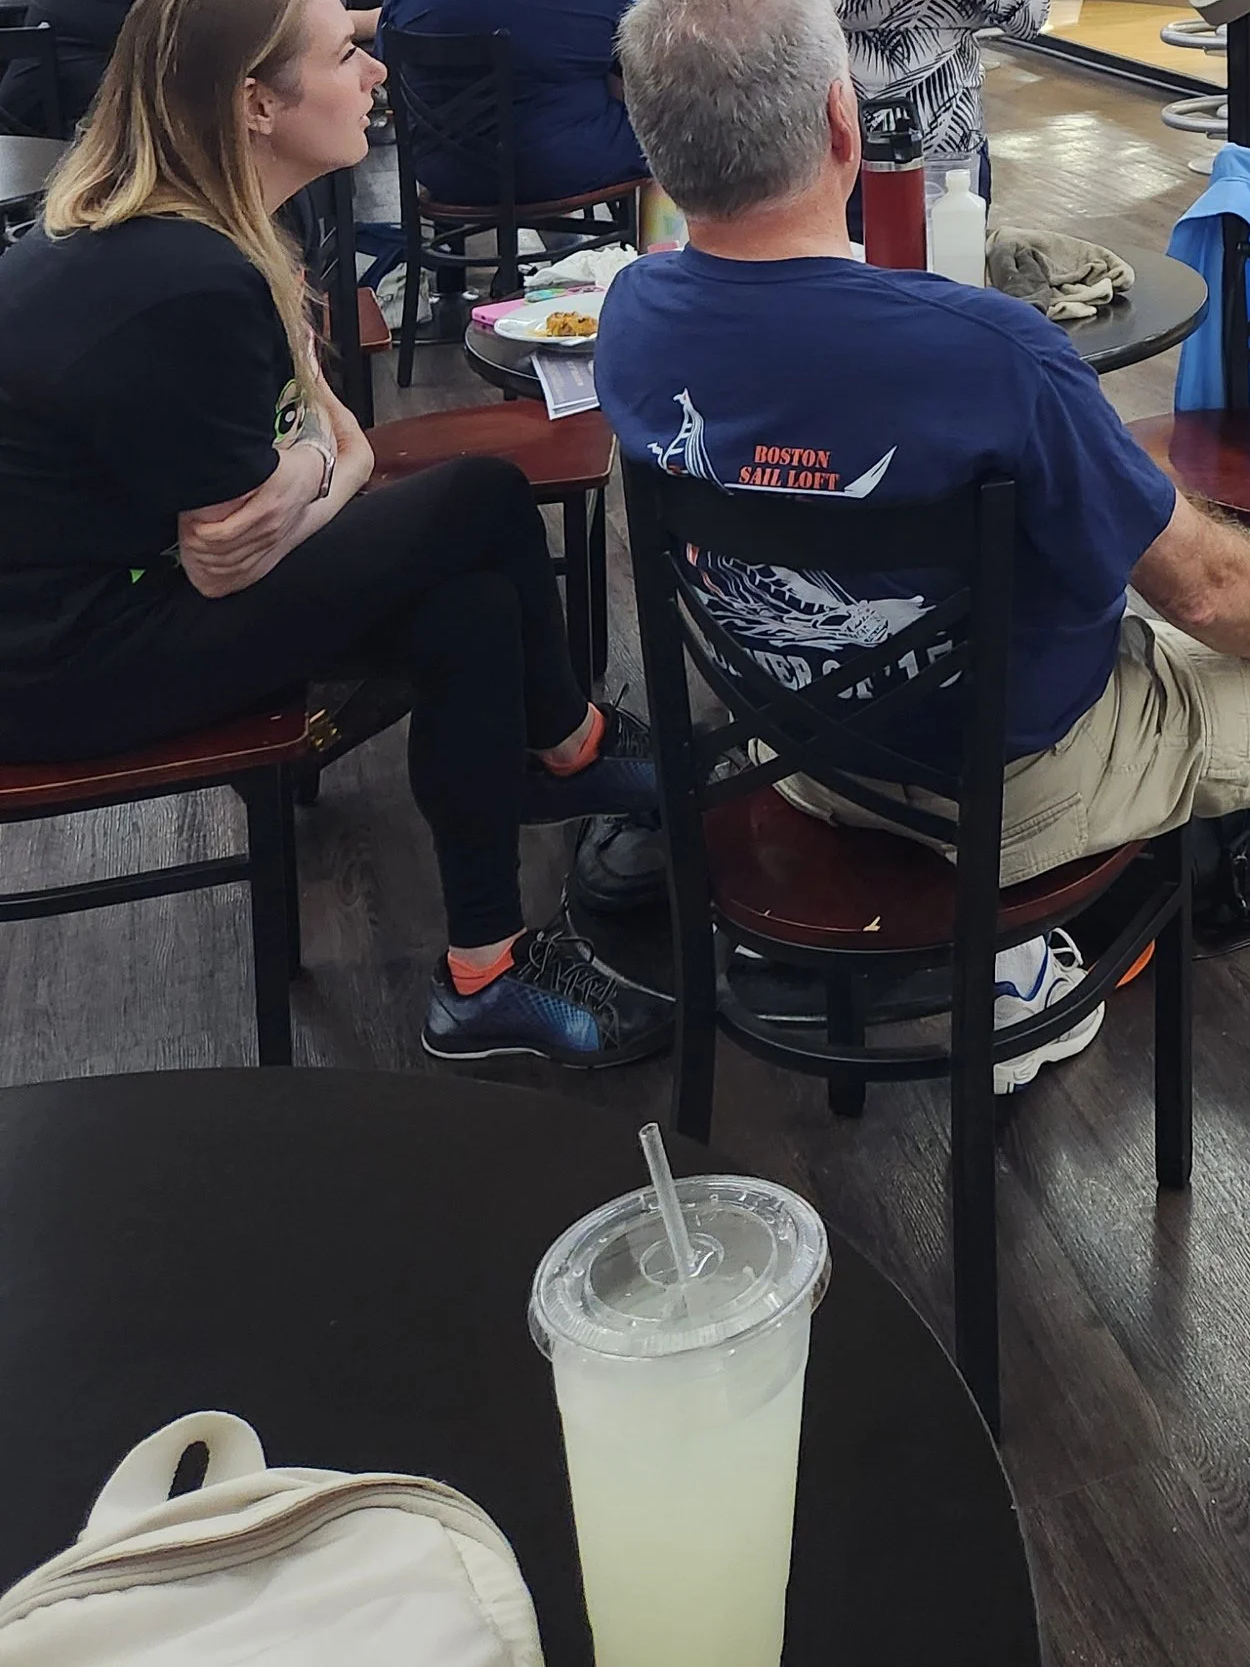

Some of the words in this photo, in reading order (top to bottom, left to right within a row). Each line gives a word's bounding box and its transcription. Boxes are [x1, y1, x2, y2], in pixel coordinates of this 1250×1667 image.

[754, 445, 831, 468] BOSTON
[739, 466, 782, 486] SAIL
[787, 470, 840, 490] LOFT
